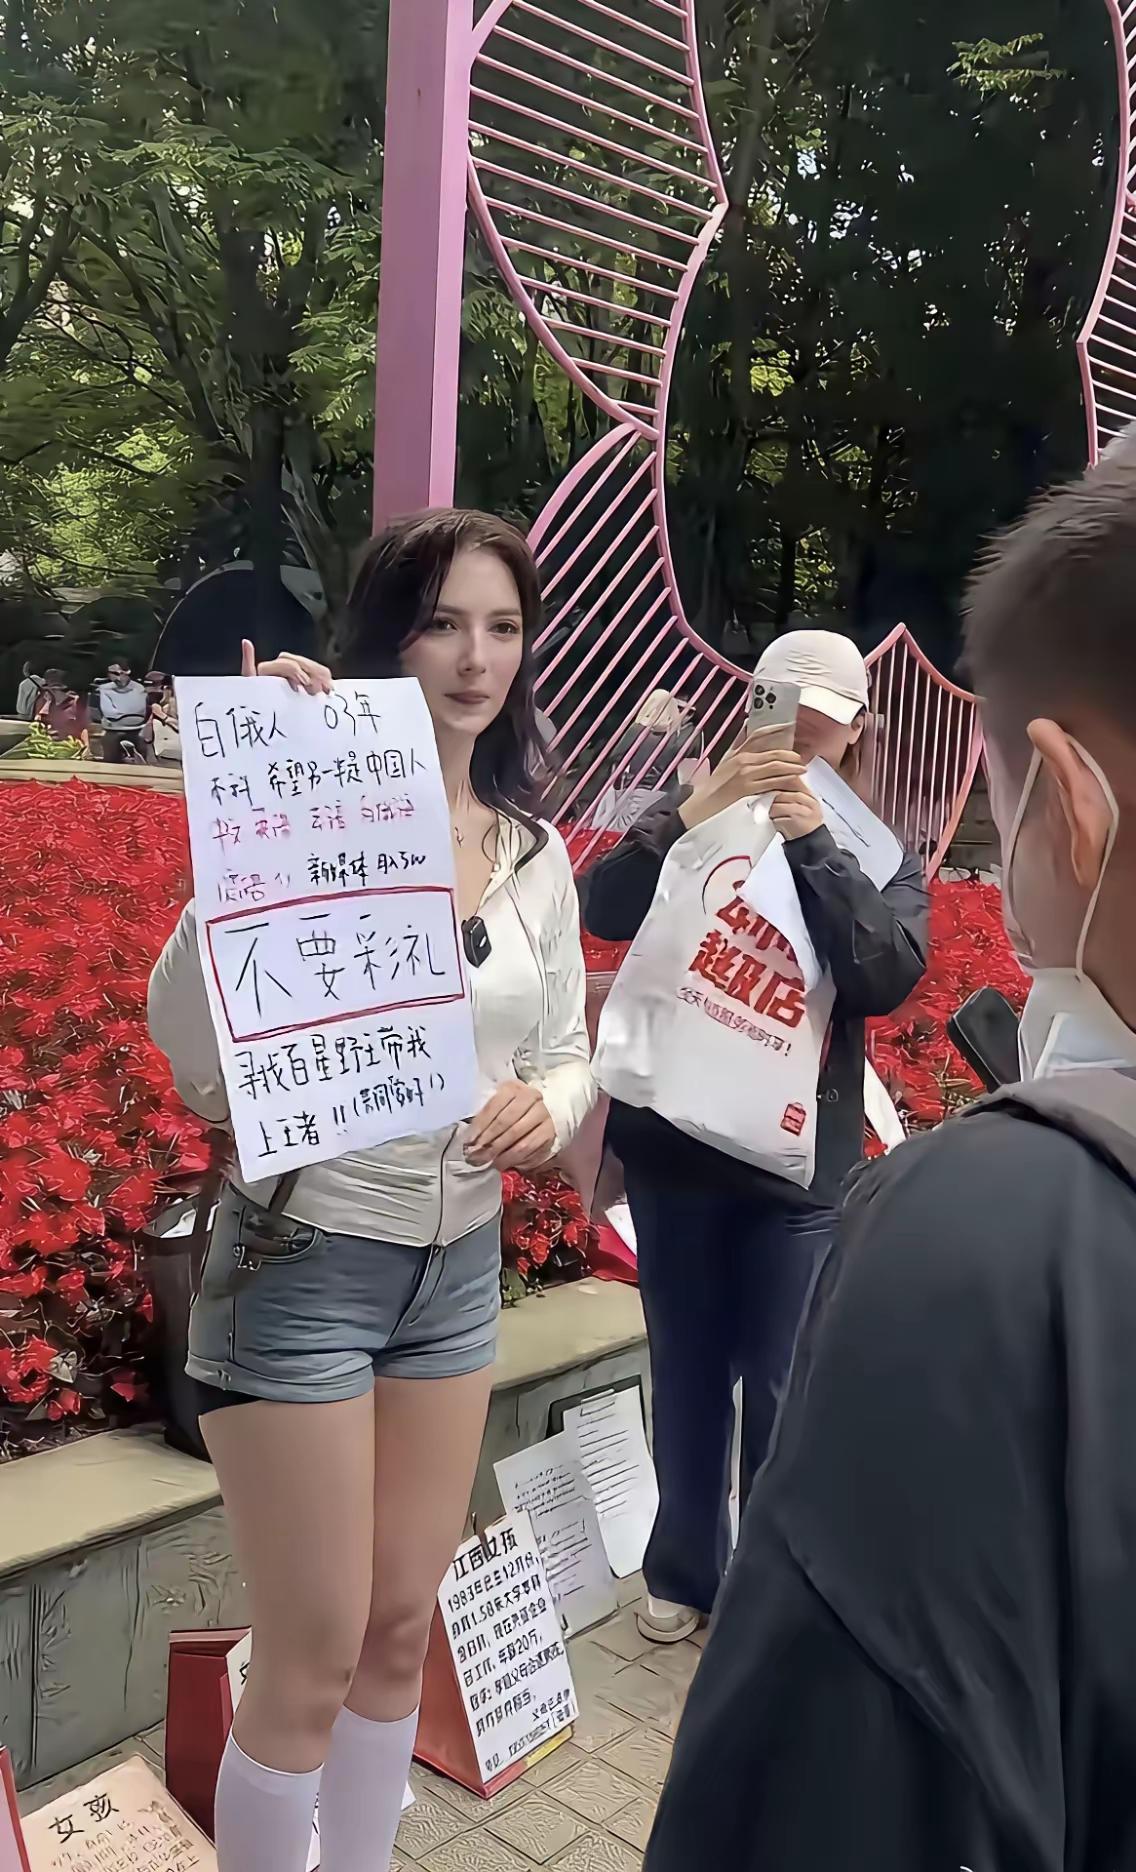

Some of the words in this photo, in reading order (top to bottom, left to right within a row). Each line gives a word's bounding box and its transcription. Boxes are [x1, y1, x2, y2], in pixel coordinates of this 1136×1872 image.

[195, 701, 287, 758] 白俄人
[224, 913, 446, 1018] 不要彩礼
[48, 1792, 120, 1844] 女孩
